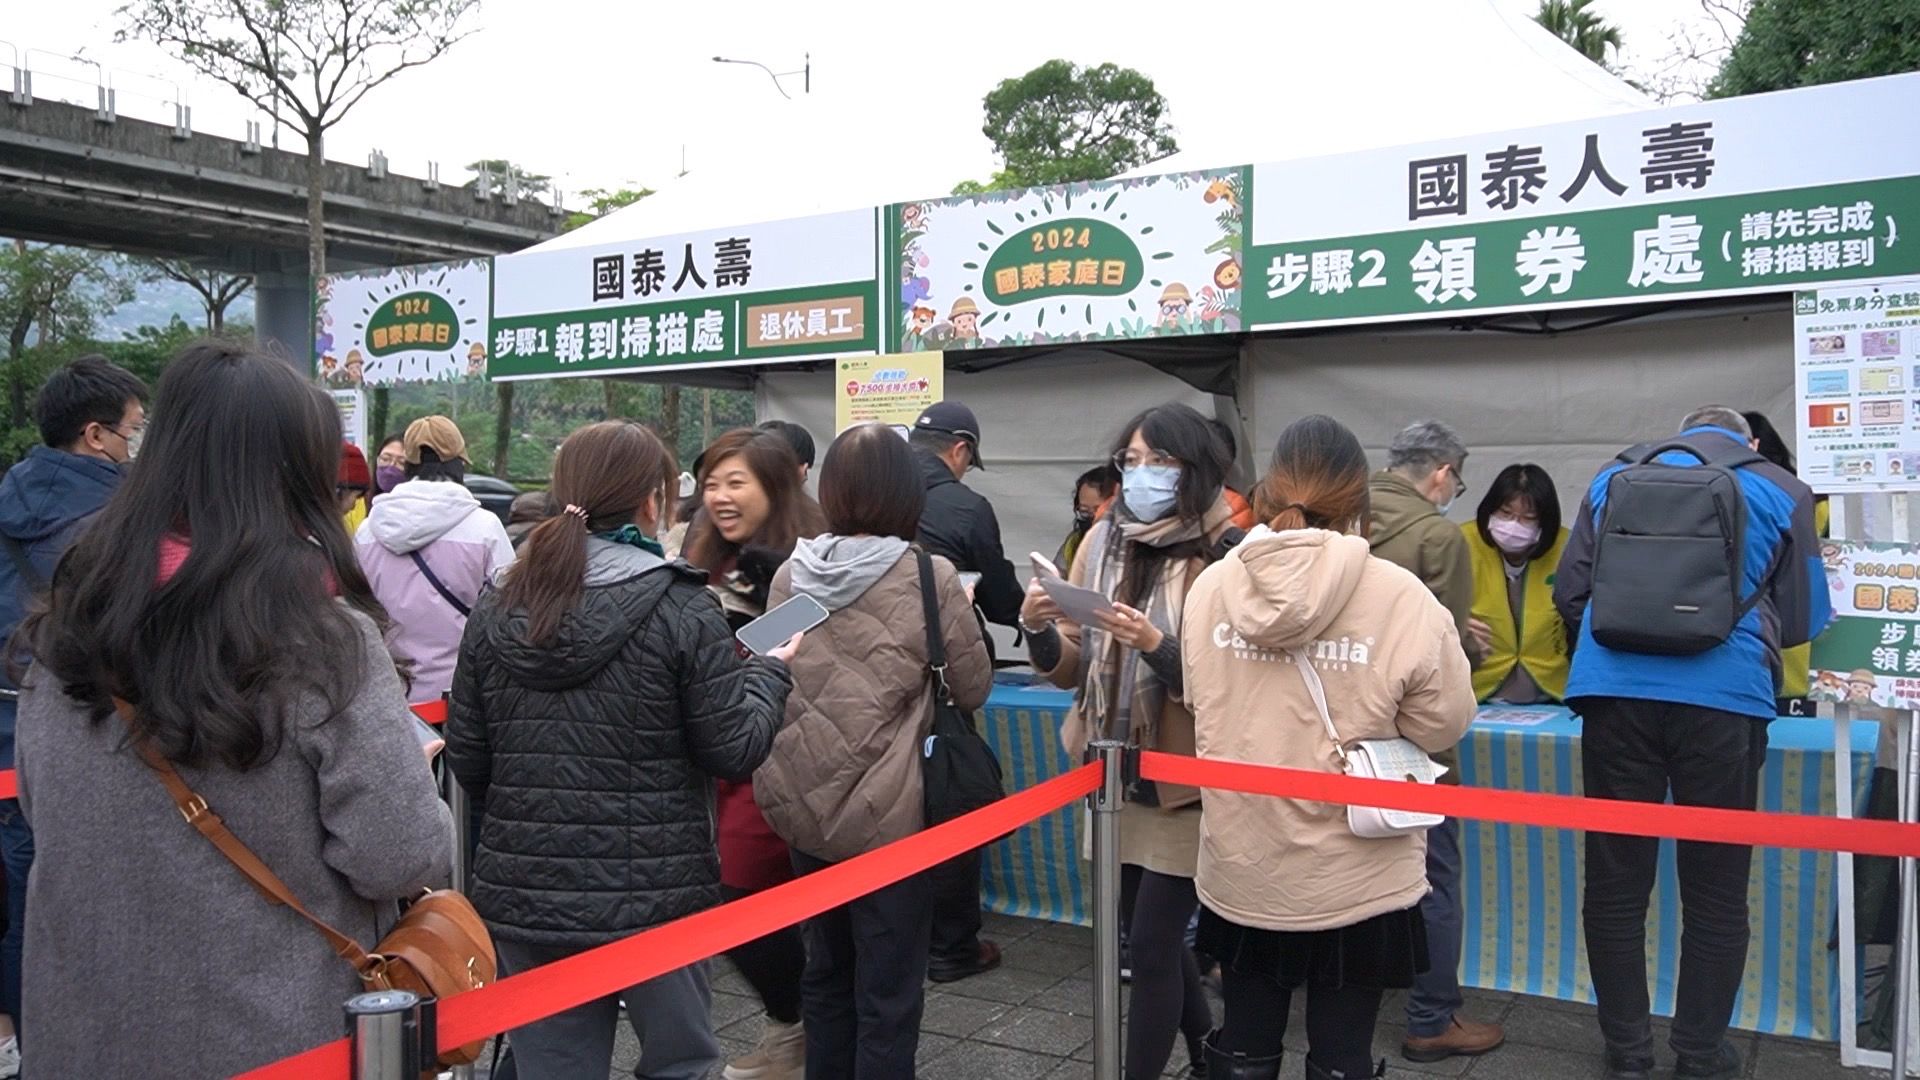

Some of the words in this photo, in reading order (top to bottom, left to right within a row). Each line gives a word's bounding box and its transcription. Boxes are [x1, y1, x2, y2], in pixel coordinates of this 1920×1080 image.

[1407, 121, 1716, 221] 國泰人壽
[1031, 227, 1091, 252] 2024
[592, 236, 753, 302] 國泰人壽
[994, 259, 1127, 296] 國泰家庭日
[1265, 248, 1387, 298] 步驟2
[394, 298, 430, 317] 2024
[758, 307, 855, 342] 退休員工
[494, 326, 549, 358] 步驟1
[554, 309, 726, 364] 報到掃描處
